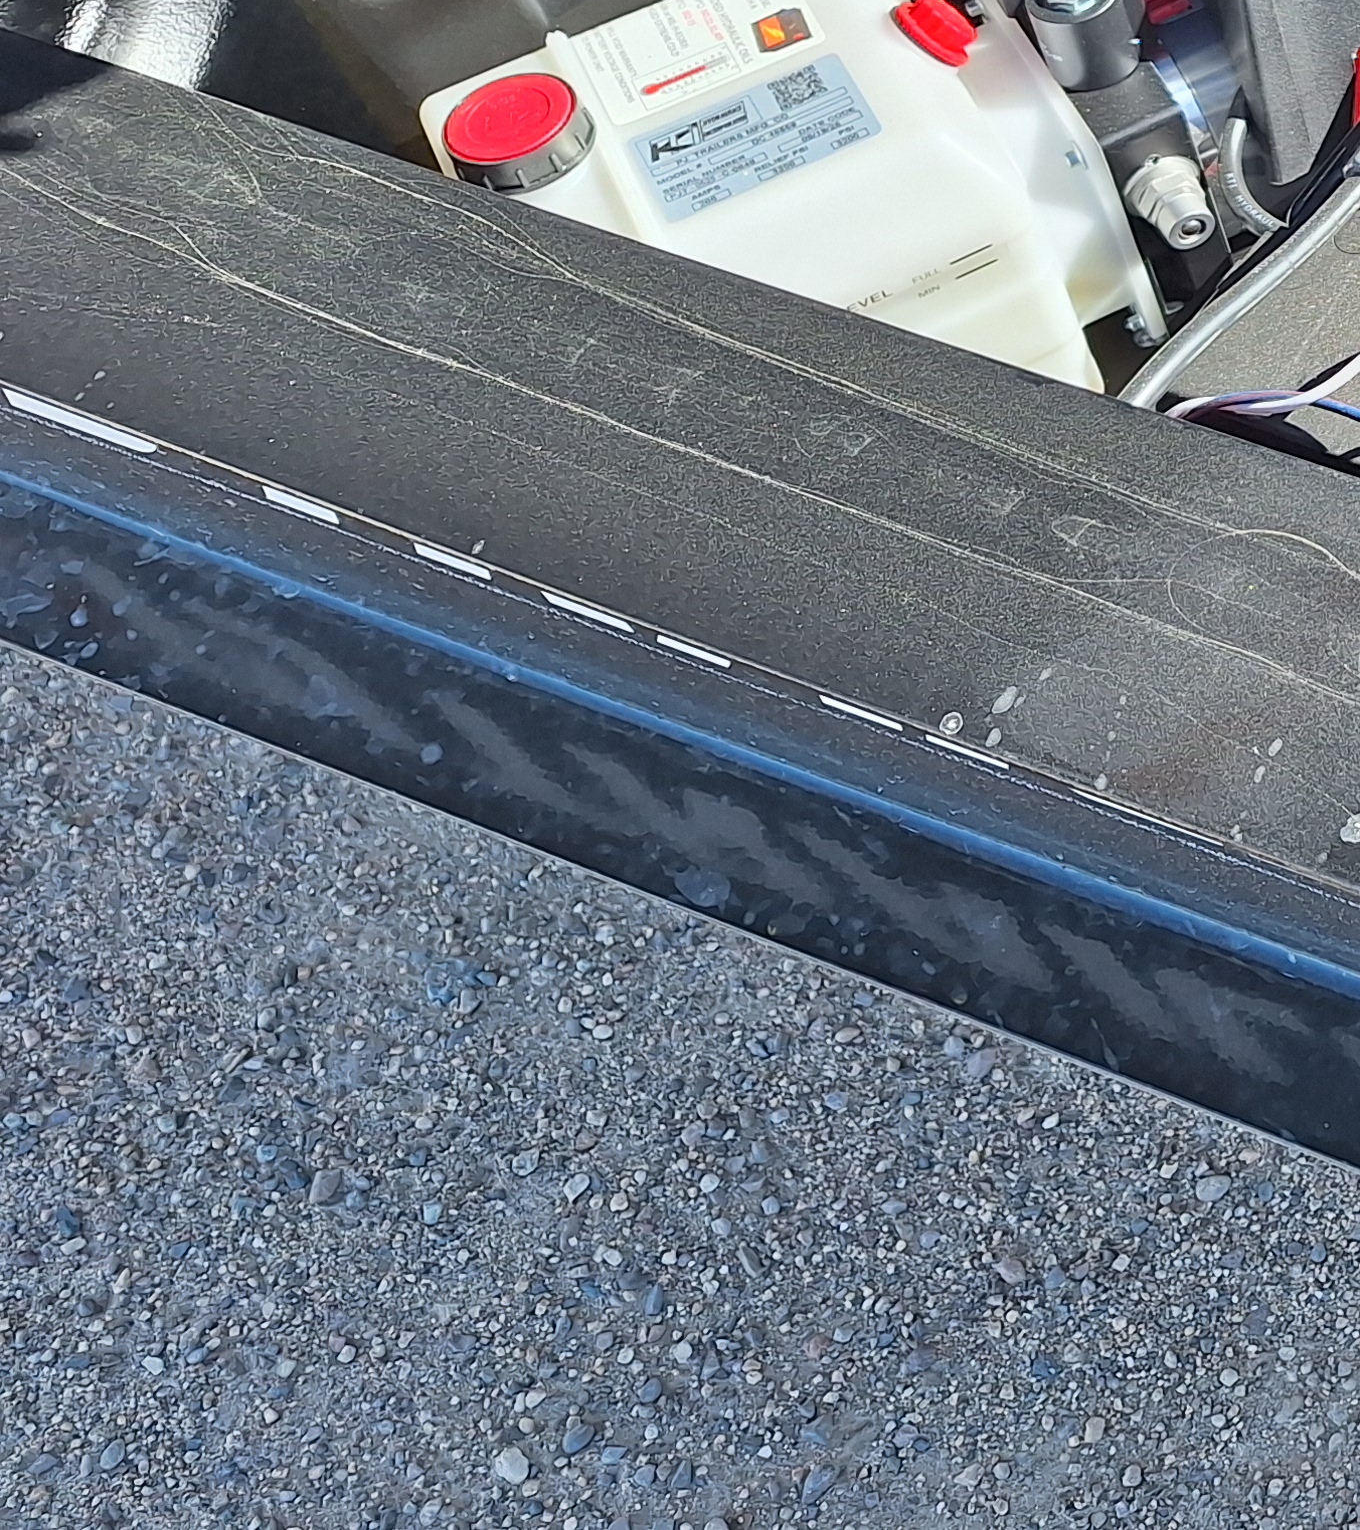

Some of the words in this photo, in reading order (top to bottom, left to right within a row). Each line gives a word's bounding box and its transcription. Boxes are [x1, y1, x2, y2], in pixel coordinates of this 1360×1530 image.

[796, 119, 825, 135] DATE
[825, 106, 855, 122] CODE
[837, 124, 855, 136] PSI
[674, 154, 689, 166] PJ
[692, 131, 745, 158] TRAILERS
[753, 153, 790, 173] RELIEF
[791, 144, 809, 156] PSI
[655, 166, 694, 186] MODEL
[661, 174, 699, 194] SERIAL
[700, 154, 746, 177] NUMBER
[690, 183, 721, 201] AMPS
[912, 268, 941, 284] FULL
[846, 290, 893, 312] EVEL
[917, 285, 941, 298] MIN
